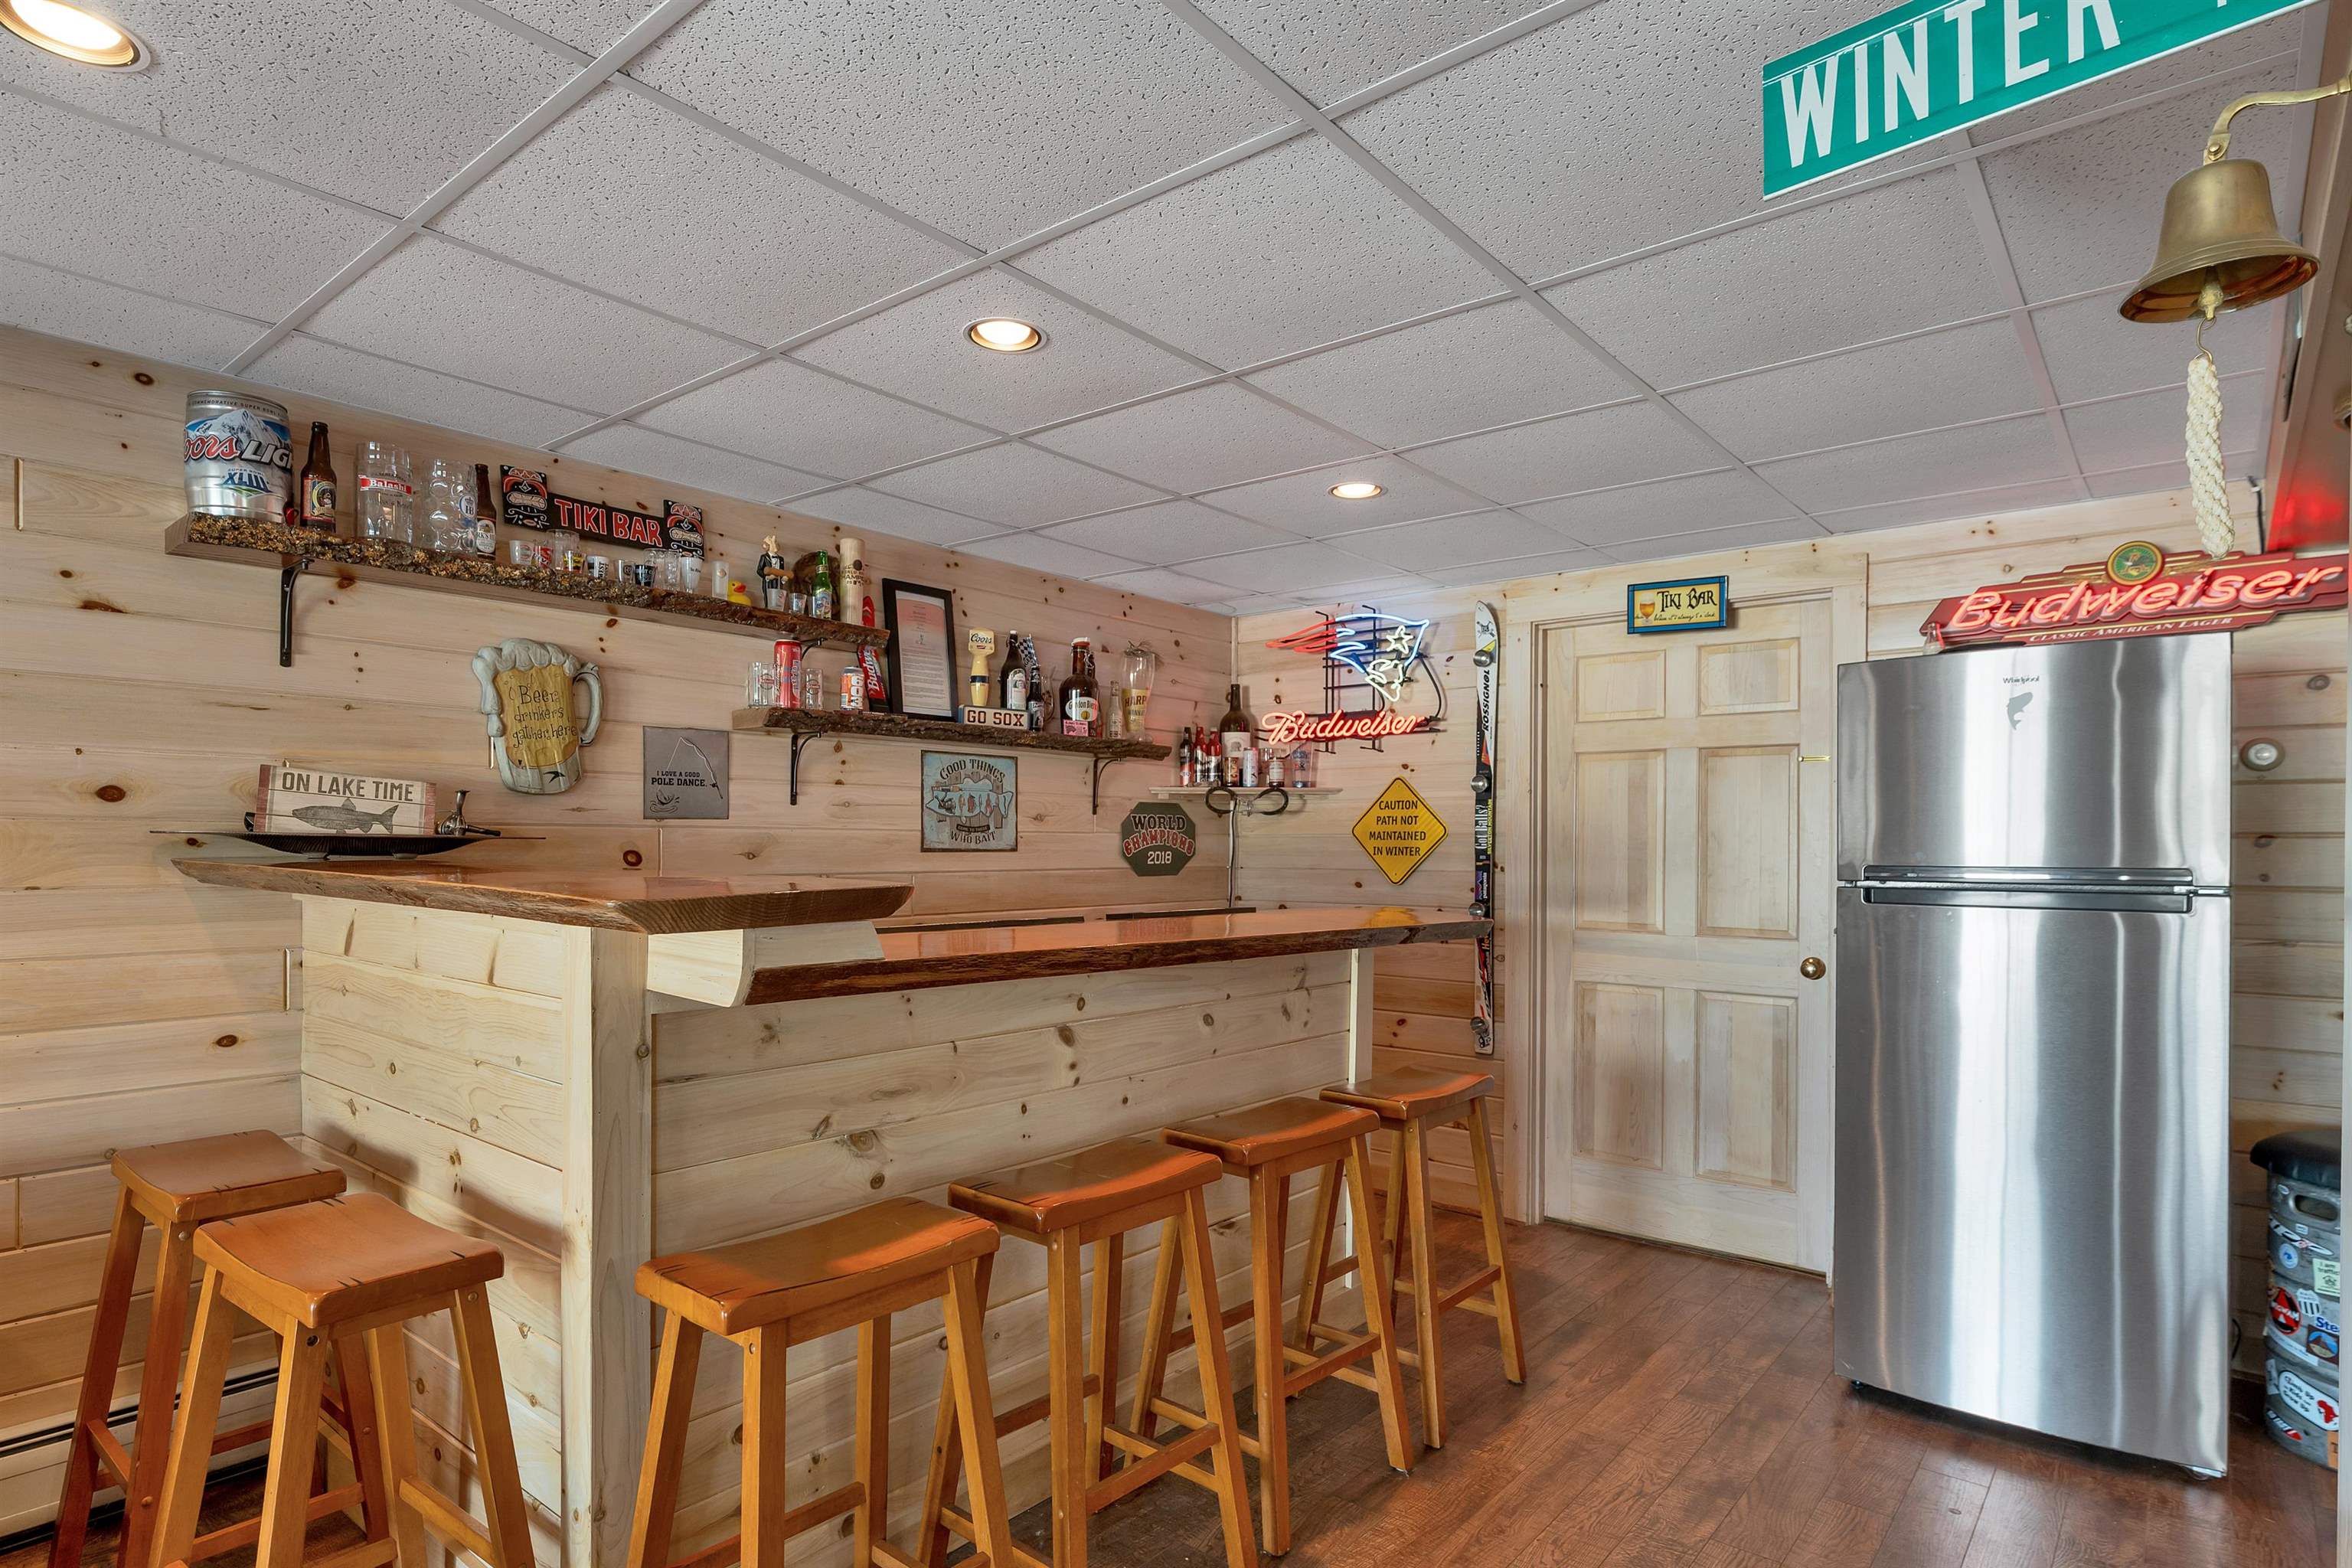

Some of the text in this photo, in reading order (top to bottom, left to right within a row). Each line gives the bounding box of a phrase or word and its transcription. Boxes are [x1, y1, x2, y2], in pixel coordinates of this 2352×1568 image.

[184, 433, 240, 461] oors
[369, 478, 407, 492] Balashi
[554, 498, 663, 547] TIKI BAR
[1657, 587, 1718, 612] TIKI BAR
[1952, 566, 2344, 629] Budweiser
[2030, 616, 2233, 642] CLASSIC AMERICAN LAGER
[970, 632, 992, 644] Coors
[2002, 675, 2040, 684] Whirlpool
[519, 685, 559, 705] Beer
[1124, 694, 1147, 707] HARP
[514, 707, 564, 724] drinkers
[967, 710, 1024, 727] GO SOX
[1261, 709, 1426, 746] Budweiser
[512, 724, 577, 749] gather here
[939, 759, 1005, 783] GOOD THINGS
[282, 772, 414, 802] ON LAKE TIME
[651, 777, 708, 788] POLE DANCE.
[1379, 800, 1419, 810] CAUTION
[1130, 814, 1187, 831] WORLD
[1377, 815, 1419, 825] PATH NOT
[1475, 805, 1488, 850] Got Balls?
[951, 831, 996, 844] WHO BAIT
[1122, 828, 1195, 858] CHAMPIONS
[1369, 831, 1426, 841] MAINTAINED
[1147, 851, 1173, 864] 2018
[1373, 846, 1421, 857] IN WINTER
